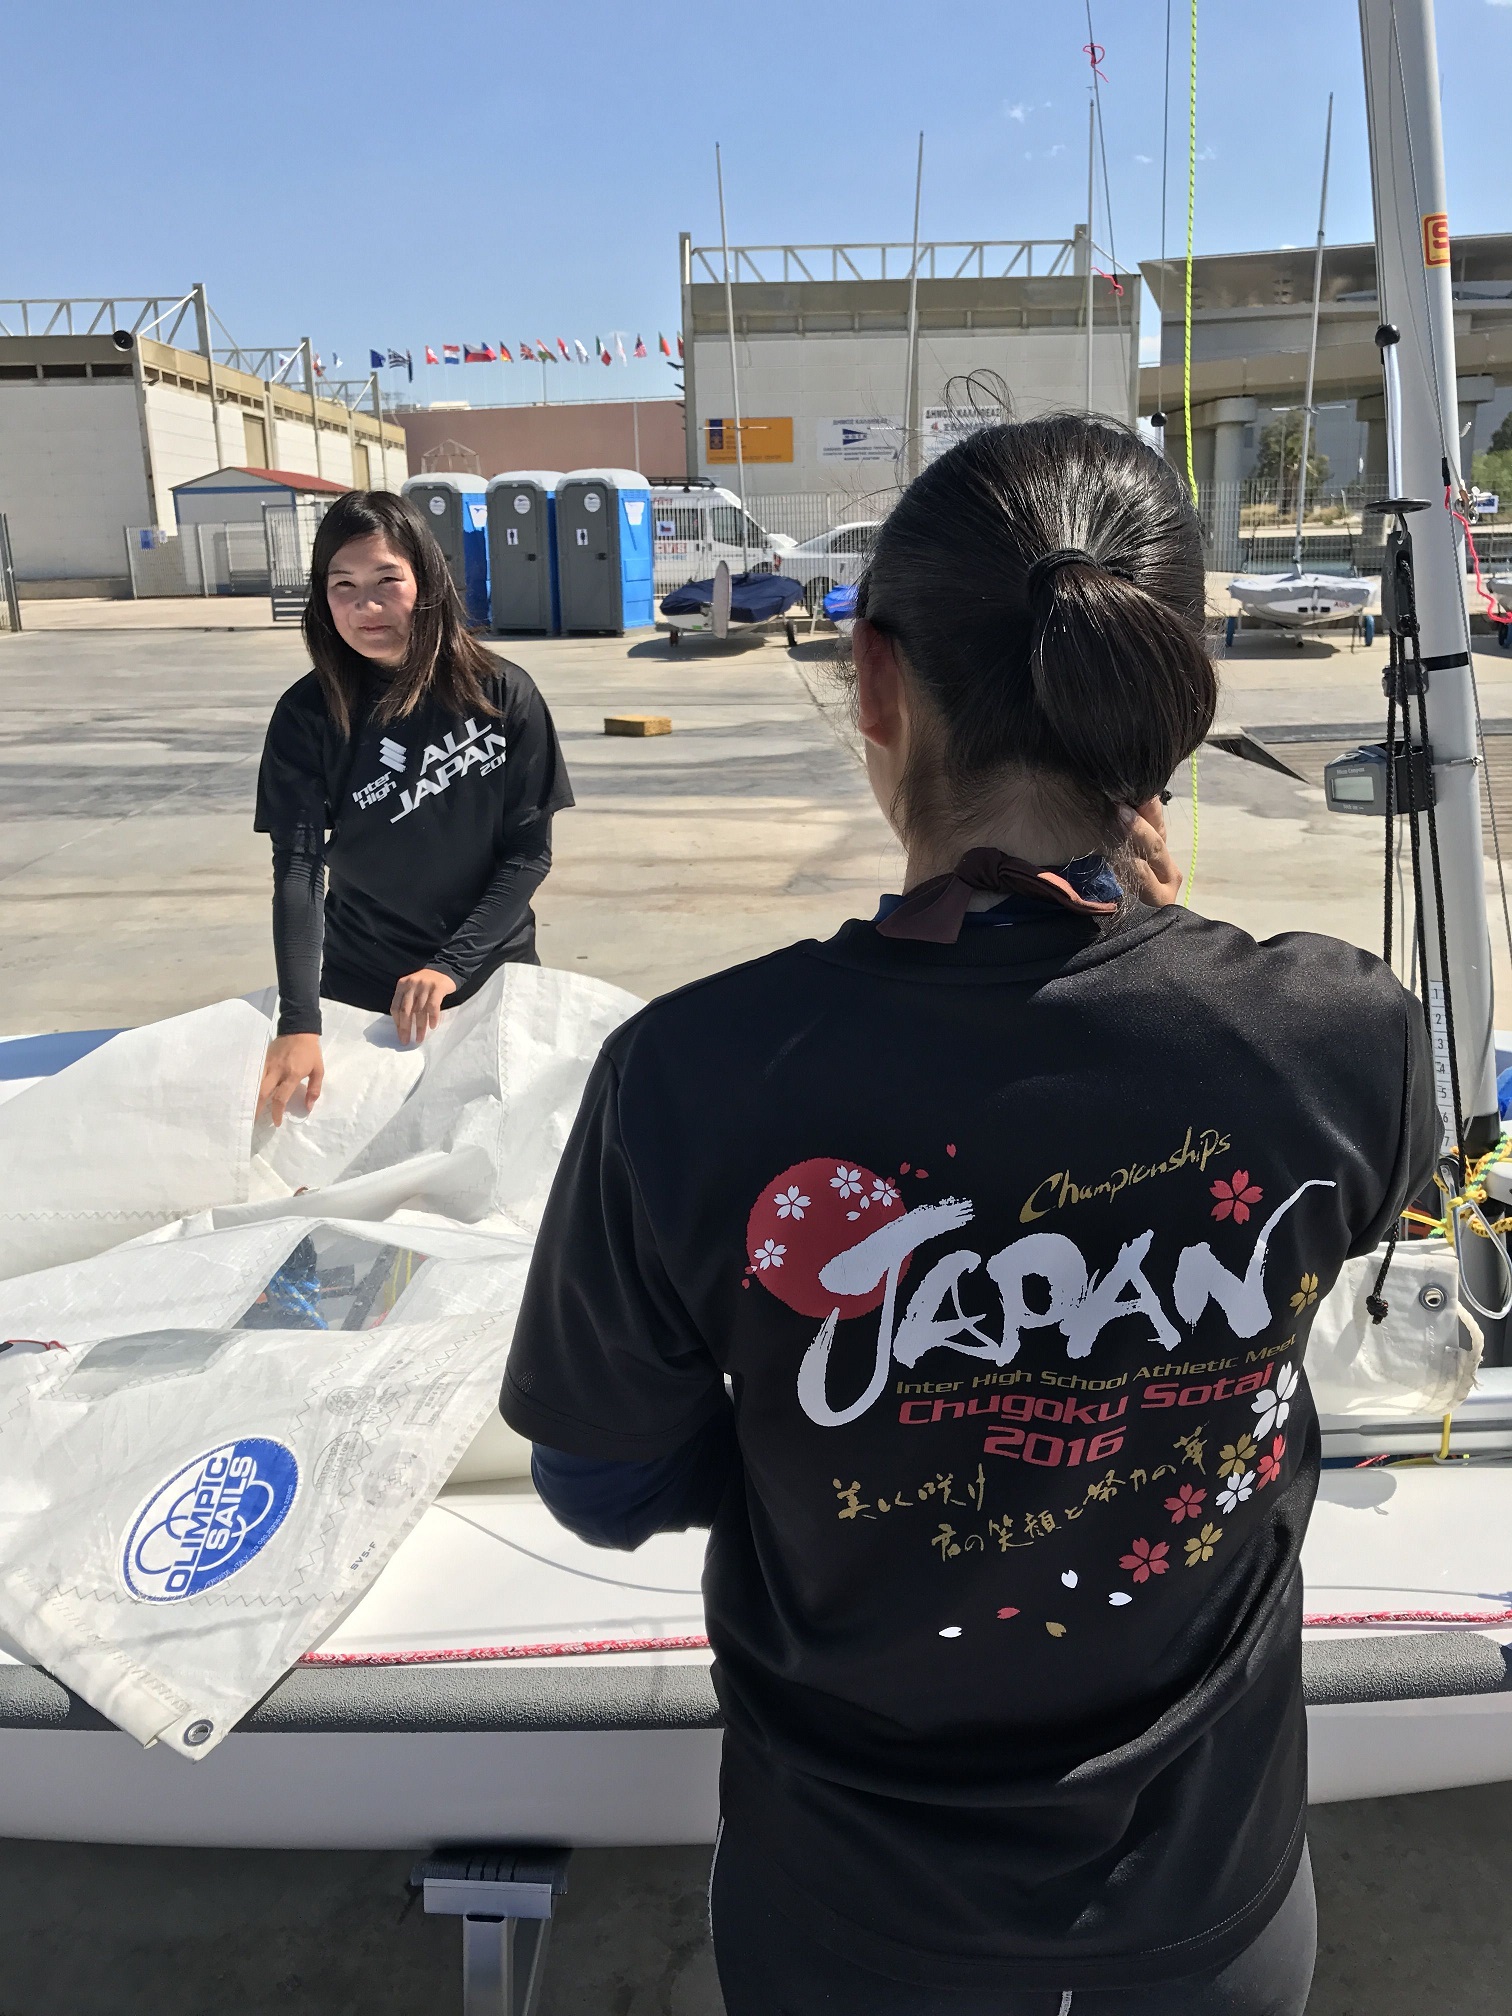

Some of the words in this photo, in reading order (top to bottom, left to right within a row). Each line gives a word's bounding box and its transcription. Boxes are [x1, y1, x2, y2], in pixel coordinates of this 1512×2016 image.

[420, 717, 492, 776] ALL
[390, 733, 506, 824] JAPAN
[480, 751, 506, 777] 201
[352, 771, 392, 802] Inter
[358, 780, 397, 810] High
[1433, 988, 1439, 1000] 1
[1435, 1013, 1442, 1025] 2
[1437, 1038, 1444, 1050] 3
[1439, 1063, 1446, 1075] 4
[1441, 1087, 1447, 1099] 5
[1443, 1112, 1449, 1123] 6
[1444, 1136, 1450, 1147] 7
[1019, 1126, 1231, 1223] Championships
[797, 1178, 1336, 1427] JAPAN
[896, 1380, 964, 1395] Inter
[972, 1369, 1032, 1388] High
[1039, 1369, 1129, 1391] School
[1132, 1354, 1238, 1381] Athletic
[899, 1392, 1130, 1426] Chugoku
[1140, 1362, 1276, 1409] Sotai
[983, 1424, 1128, 1468] 2016
[206, 1456, 253, 1551] SAILS
[163, 1456, 230, 1593] OLIMPIC
